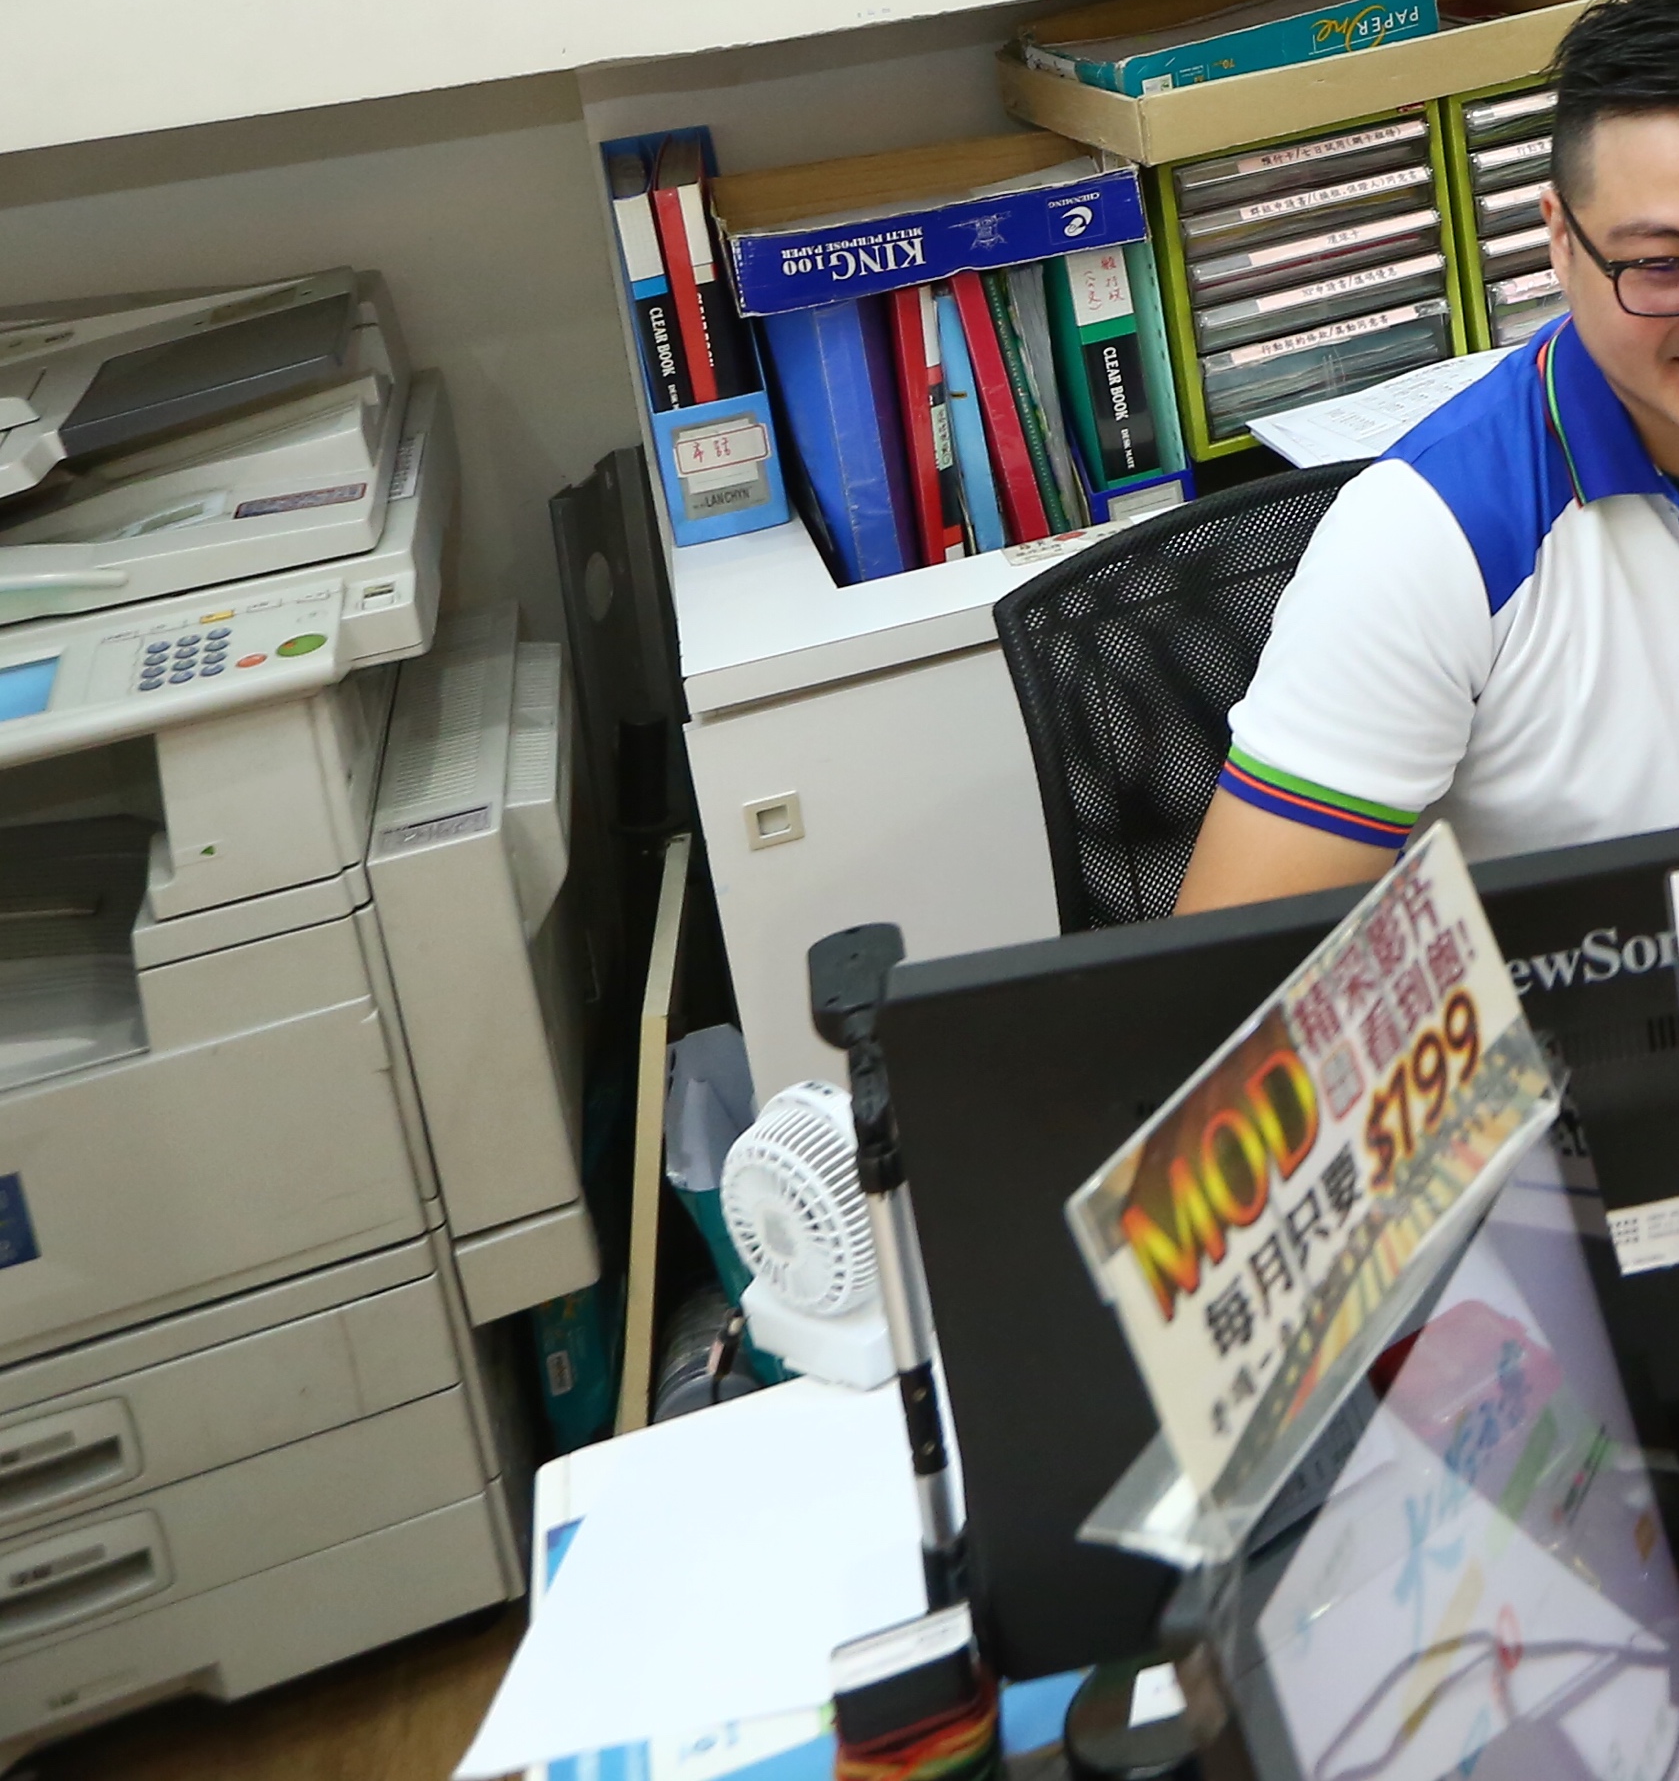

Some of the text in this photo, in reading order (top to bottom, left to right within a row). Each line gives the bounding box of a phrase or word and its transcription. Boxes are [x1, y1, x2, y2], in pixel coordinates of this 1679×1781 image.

[1048, 191, 1101, 209] CHENMING
[782, 226, 922, 259] MULTI PURPOSE PAPER
[649, 306, 668, 343] CLEAR
[657, 341, 676, 377] BOOK
[1103, 346, 1135, 469] CLEAR BOOK DESK MATE
[1291, 877, 1442, 1052] 精采影片
[1121, 1048, 1321, 1321] MOD
[1204, 1139, 1366, 1357] 每月只要
